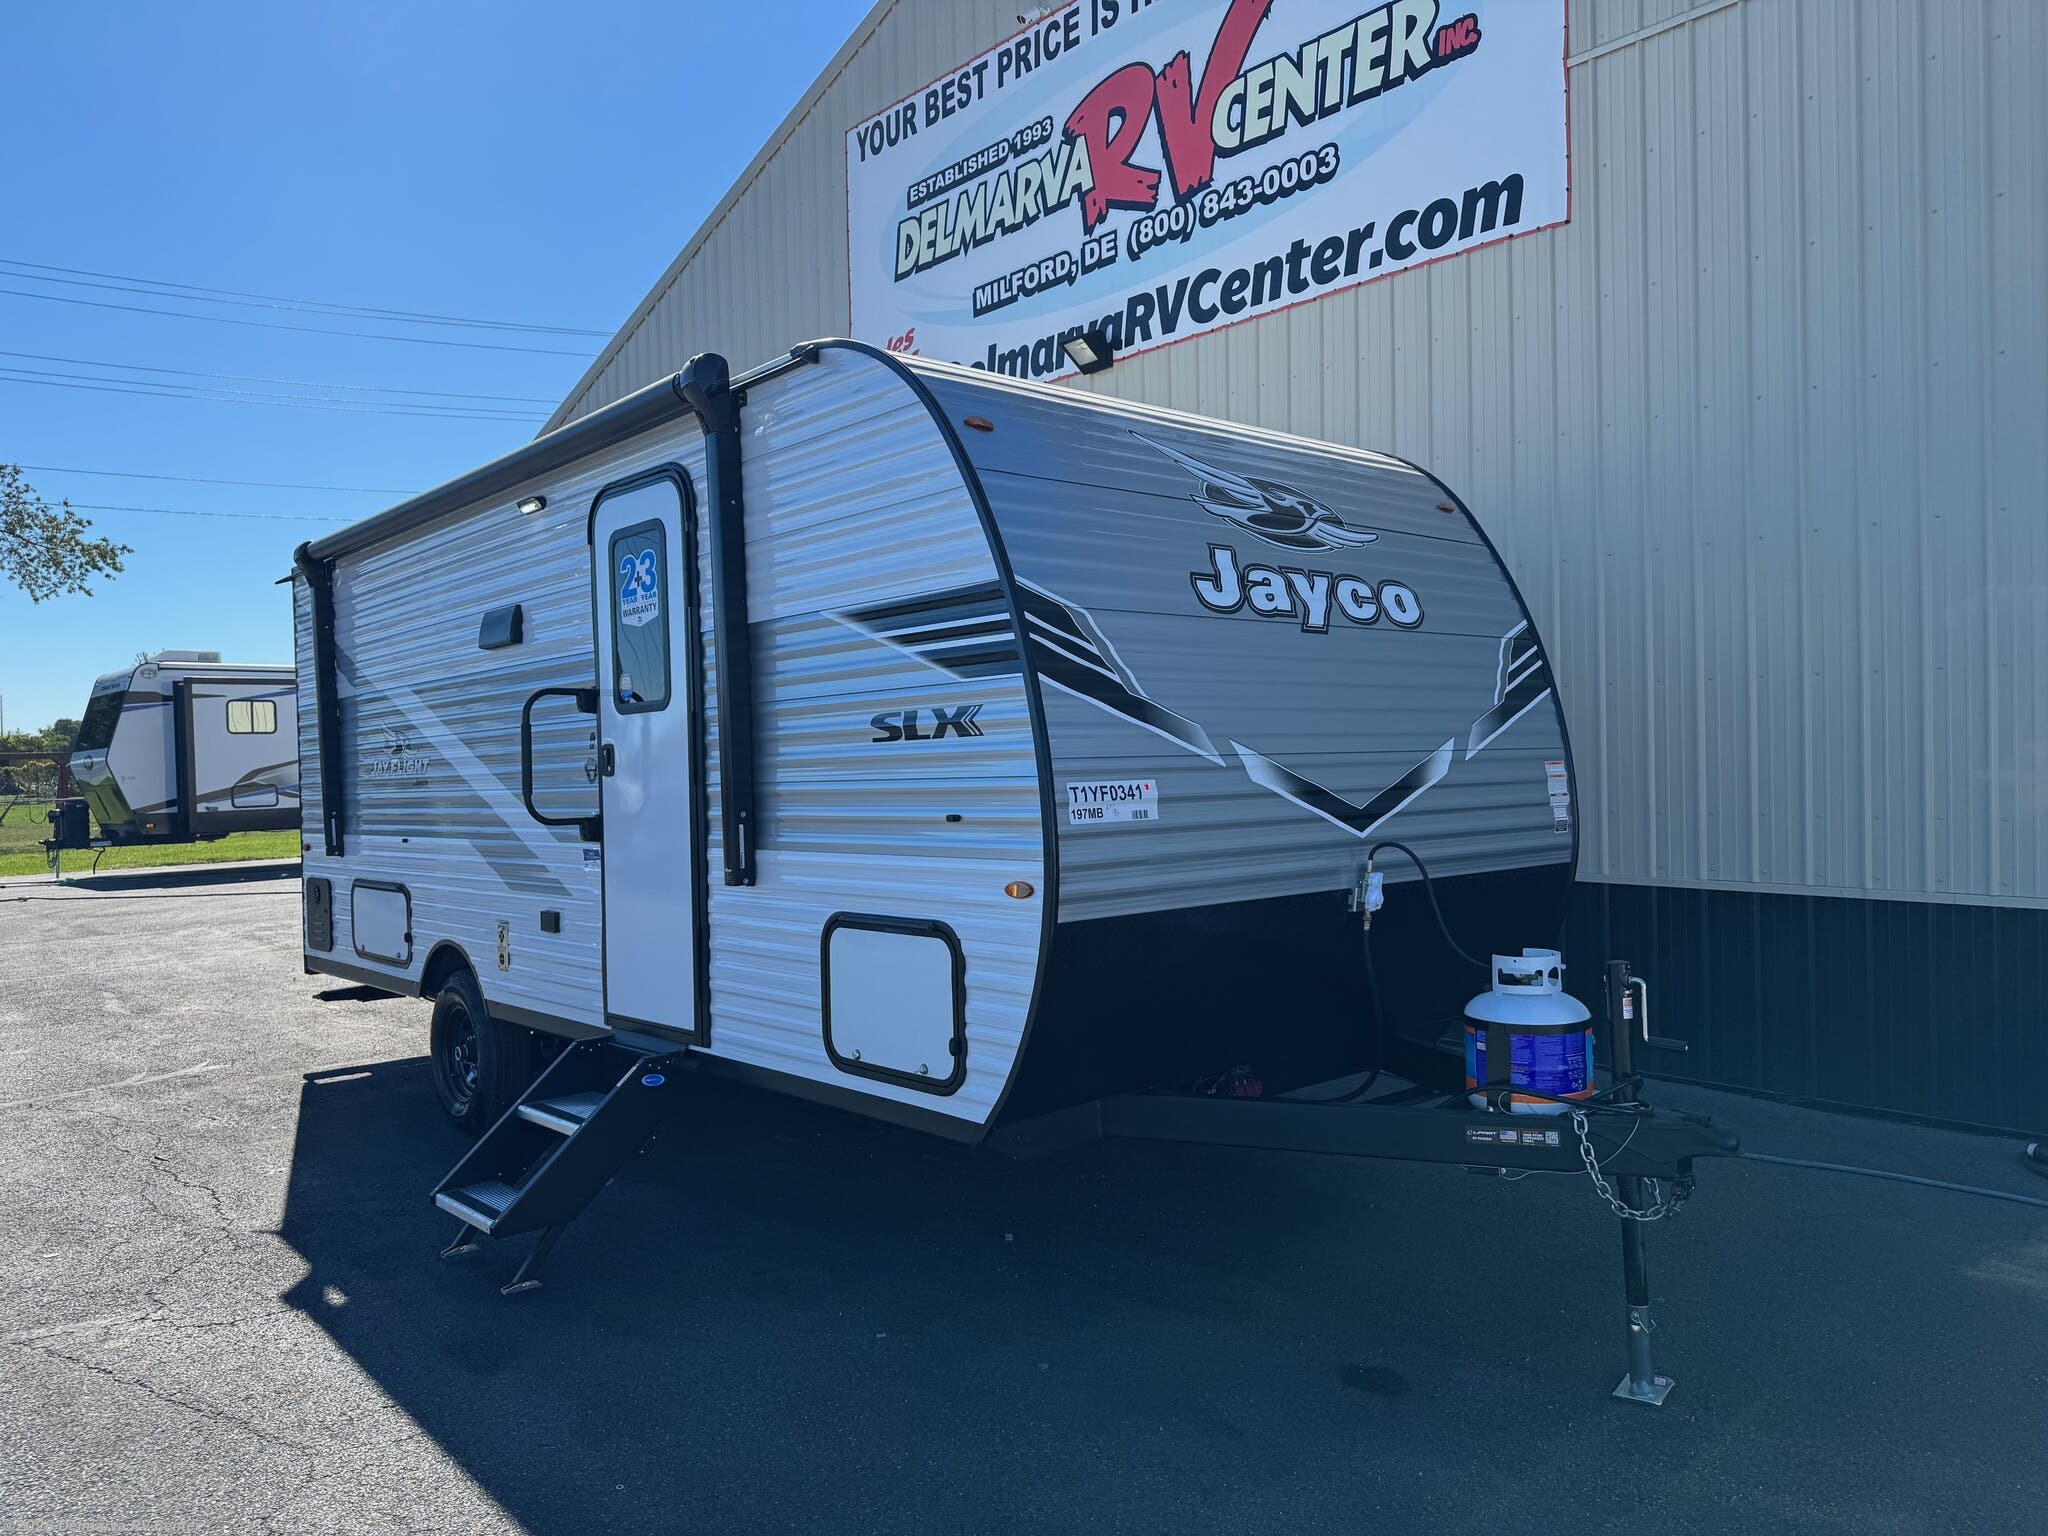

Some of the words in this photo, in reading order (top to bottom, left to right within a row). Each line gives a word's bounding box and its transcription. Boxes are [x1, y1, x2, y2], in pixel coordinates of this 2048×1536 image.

[855, 100, 918, 163] YOUR
[924, 59, 989, 129] BEST
[997, 5, 1081, 89] PRICE
[1091, 0, 1120, 37] IS
[894, 134, 1095, 281] DELMARVA
[1062, 0, 1273, 236] RV
[1210, 0, 1438, 156] CENTER
[1434, 14, 1482, 66] INC.
[908, 138, 1011, 206] ESTABLISHED
[1011, 116, 1053, 155] 1993
[973, 251, 1078, 315] MILFORD,
[1081, 231, 1117, 273] DE
[1127, 201, 1196, 257] (800)
[1201, 144, 1339, 225] 843-0003
[622, 602, 657, 618] WARRANTY
[641, 591, 657, 601] YEAR
[1190, 543, 1424, 634] Jayco
[870, 704, 984, 742] SLX
[1068, 783, 1143, 803] T1YF0341
[1071, 807, 1105, 820] 197MB
